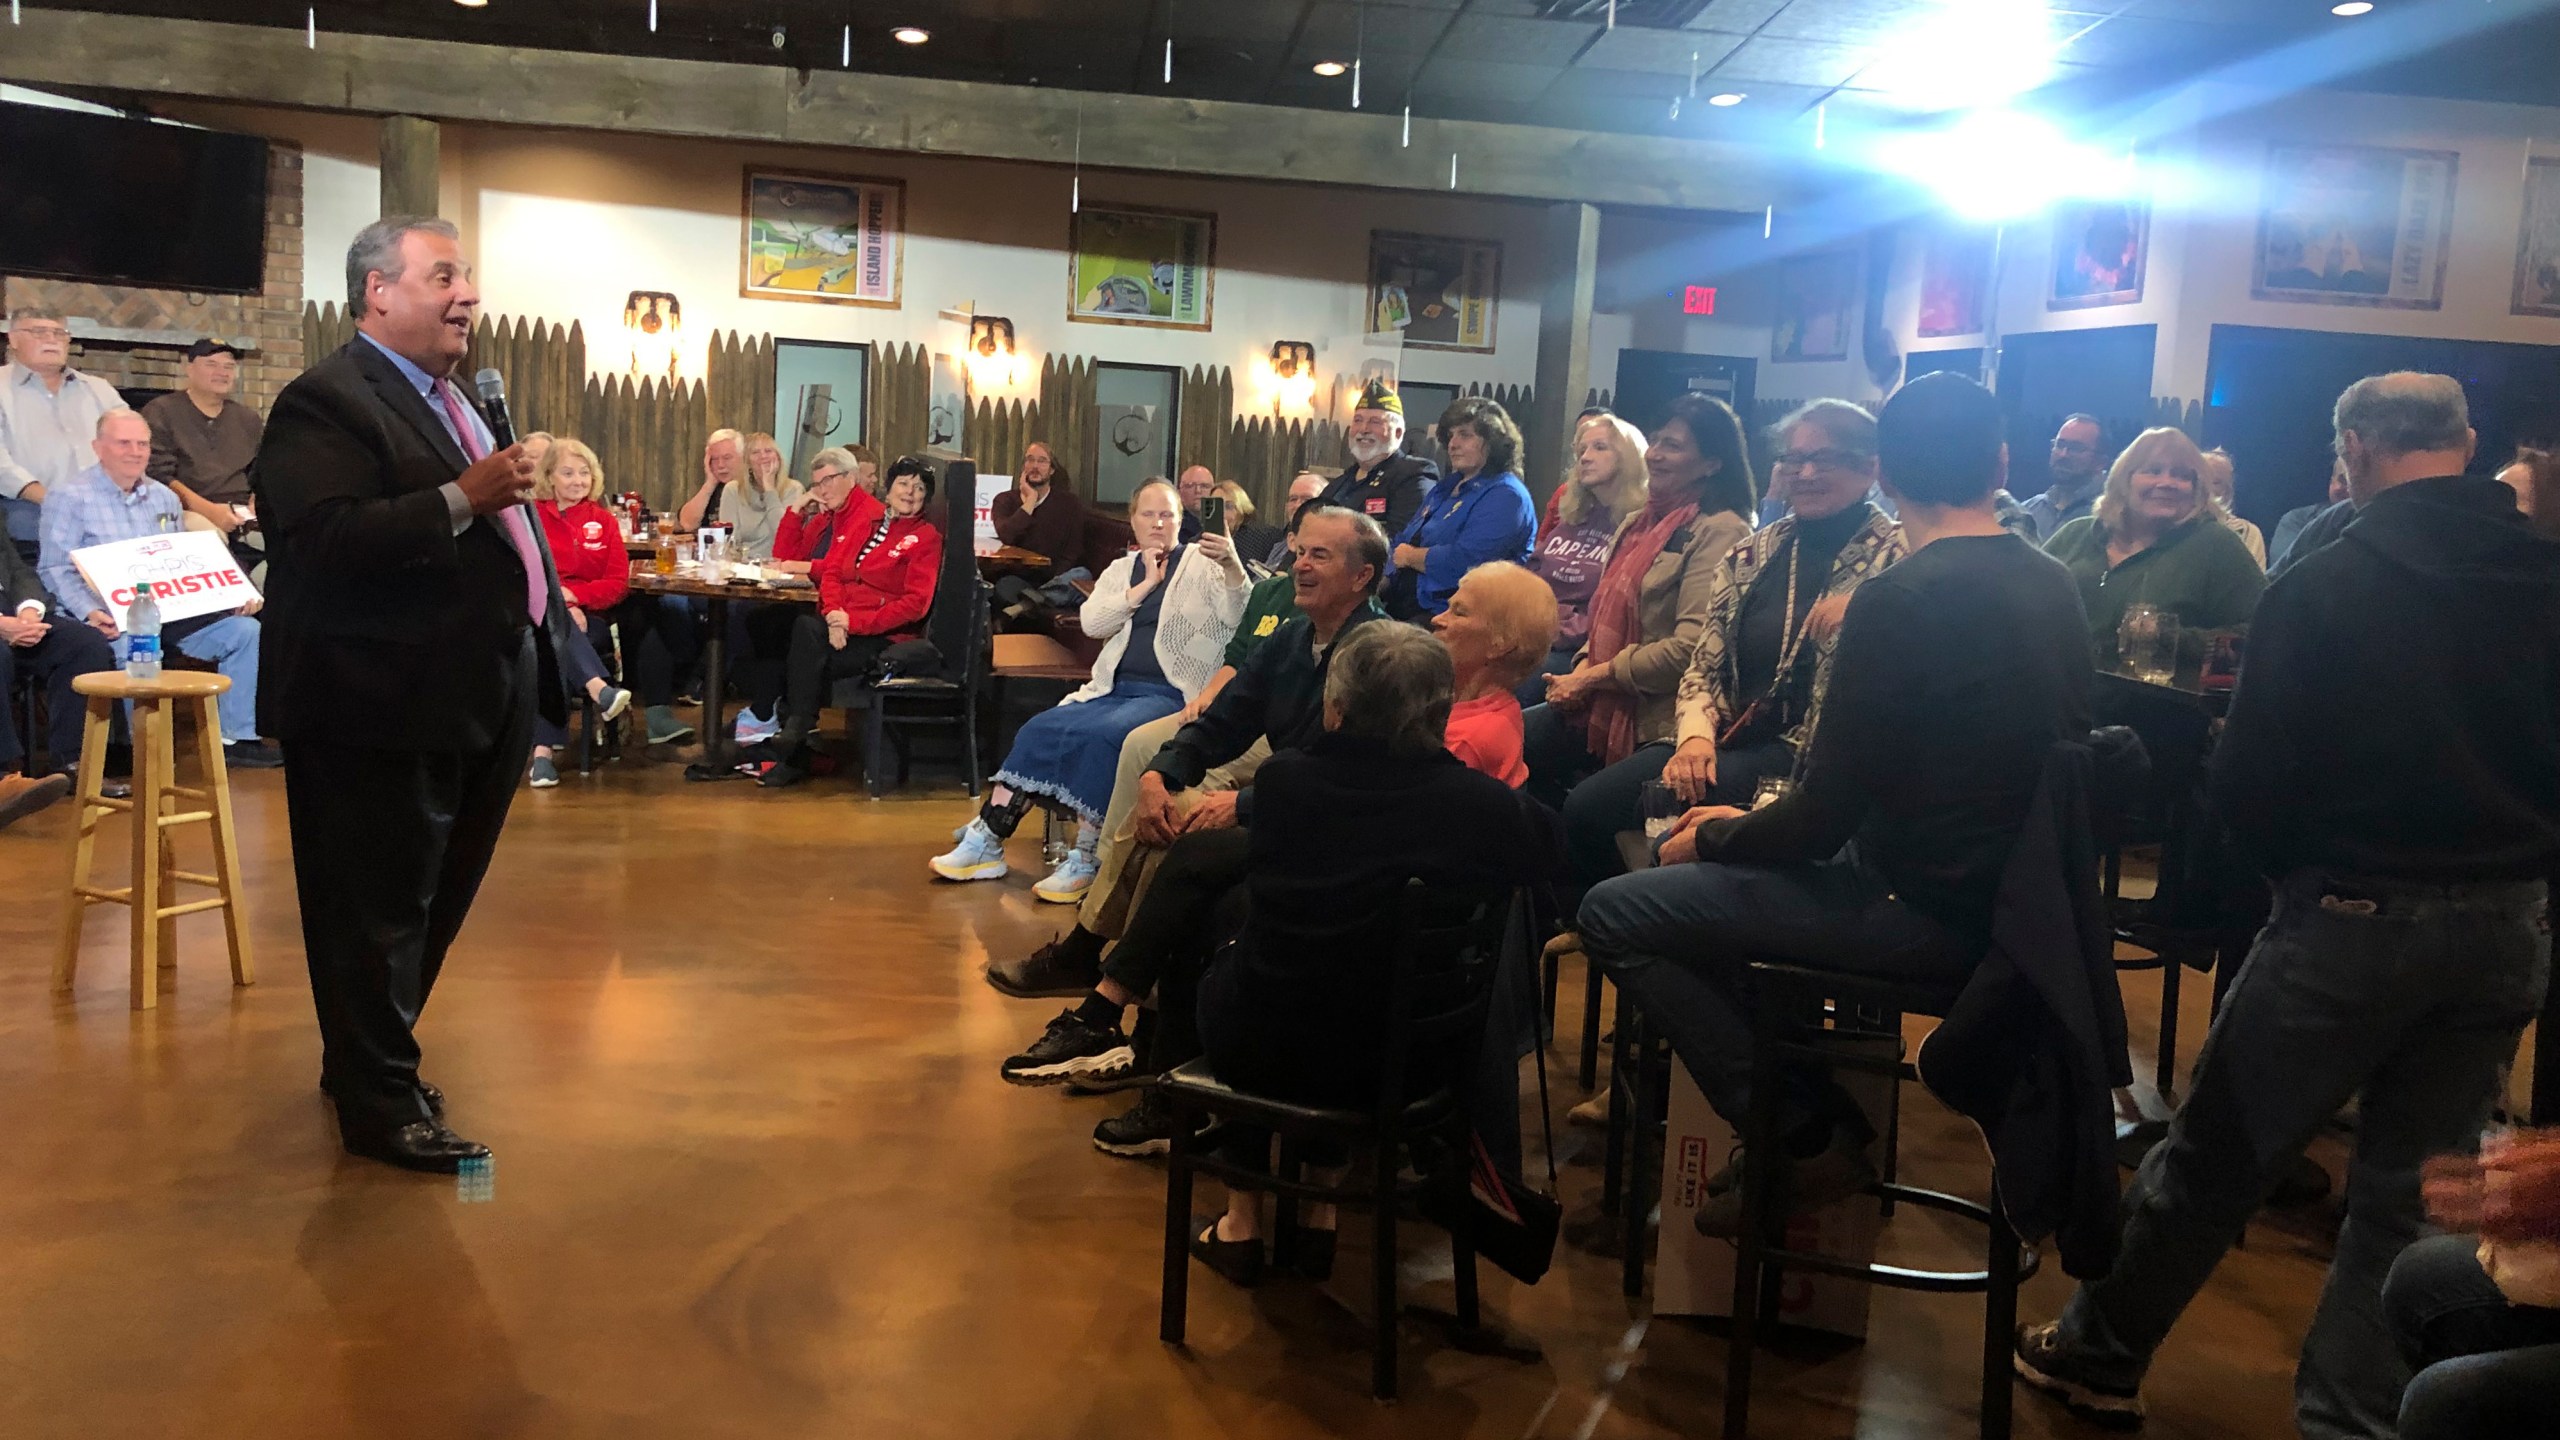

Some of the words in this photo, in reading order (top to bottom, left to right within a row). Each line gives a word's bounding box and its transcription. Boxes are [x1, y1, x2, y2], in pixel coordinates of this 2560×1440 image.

[866, 245, 881, 286] ISLAND
[1684, 286, 1717, 314] EXIT
[1544, 536, 1590, 559] CAPE
[127, 554, 205, 581] CHRIS
[1688, 1143, 1698, 1156] IS
[1687, 1162, 1697, 1173] IT
[1685, 1179, 1696, 1208] LIKE
